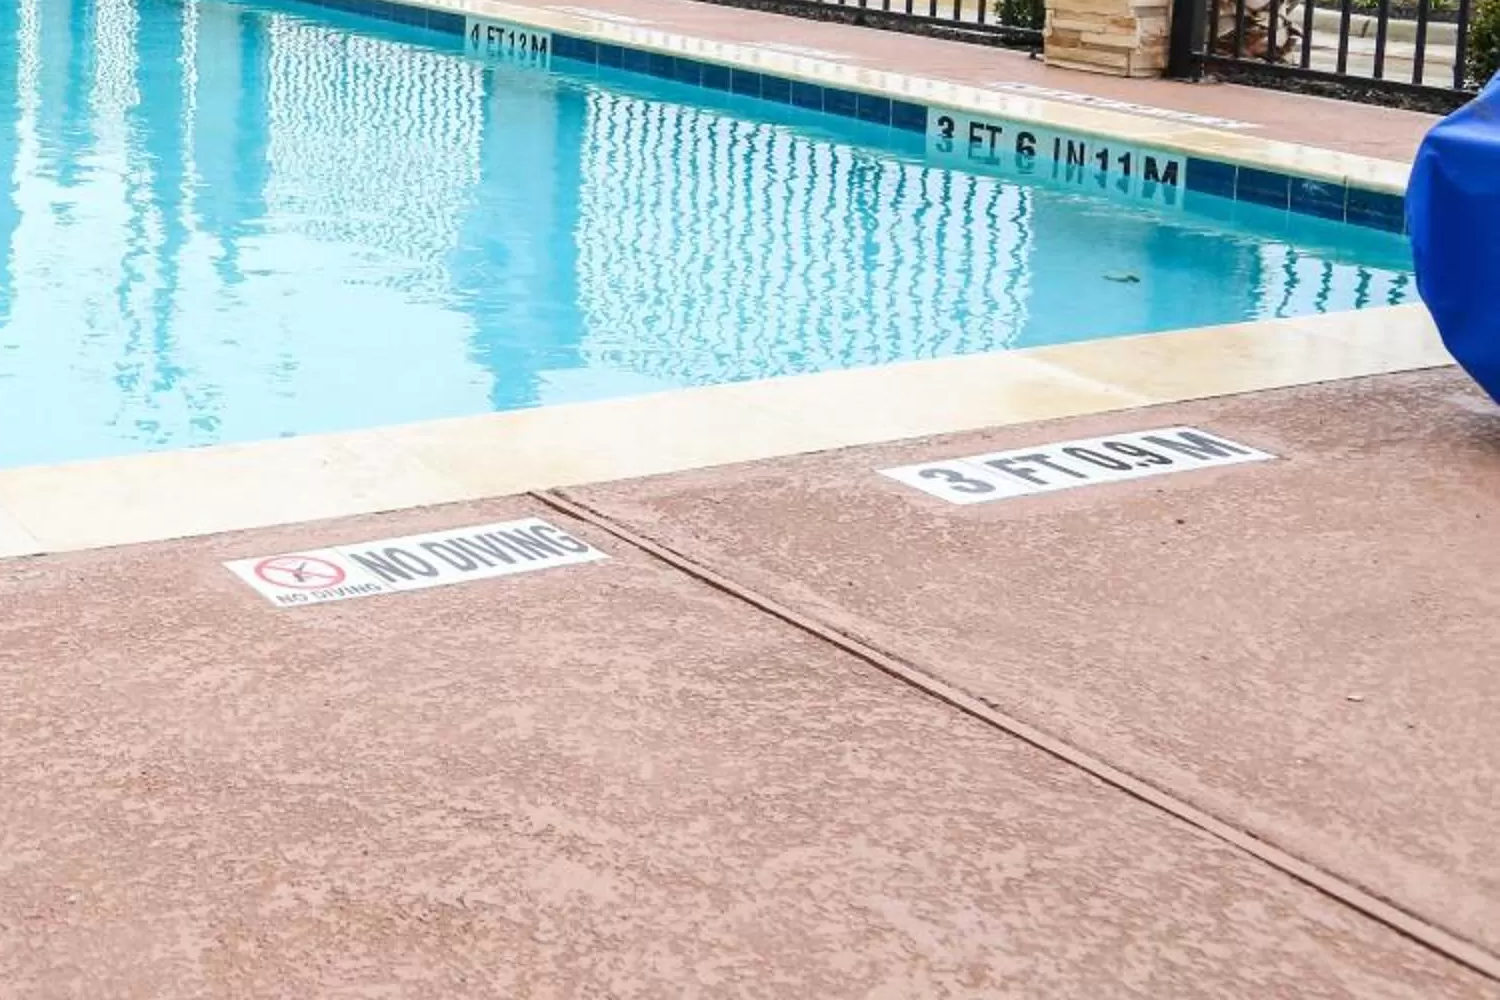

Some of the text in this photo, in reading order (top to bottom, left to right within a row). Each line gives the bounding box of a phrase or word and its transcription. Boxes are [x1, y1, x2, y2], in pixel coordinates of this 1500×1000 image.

[487, 26, 505, 43] FT
[531, 34, 547, 53] M
[937, 115, 955, 139] 3
[968, 121, 1002, 147] FT
[1016, 131, 1036, 157] 6
[1053, 137, 1086, 167] IN
[1143, 156, 1178, 186] M
[918, 431, 1253, 494] 3 FT 0.9 M
[350, 525, 590, 584] NO DIVING
[276, 583, 382, 603] NO DIVING
